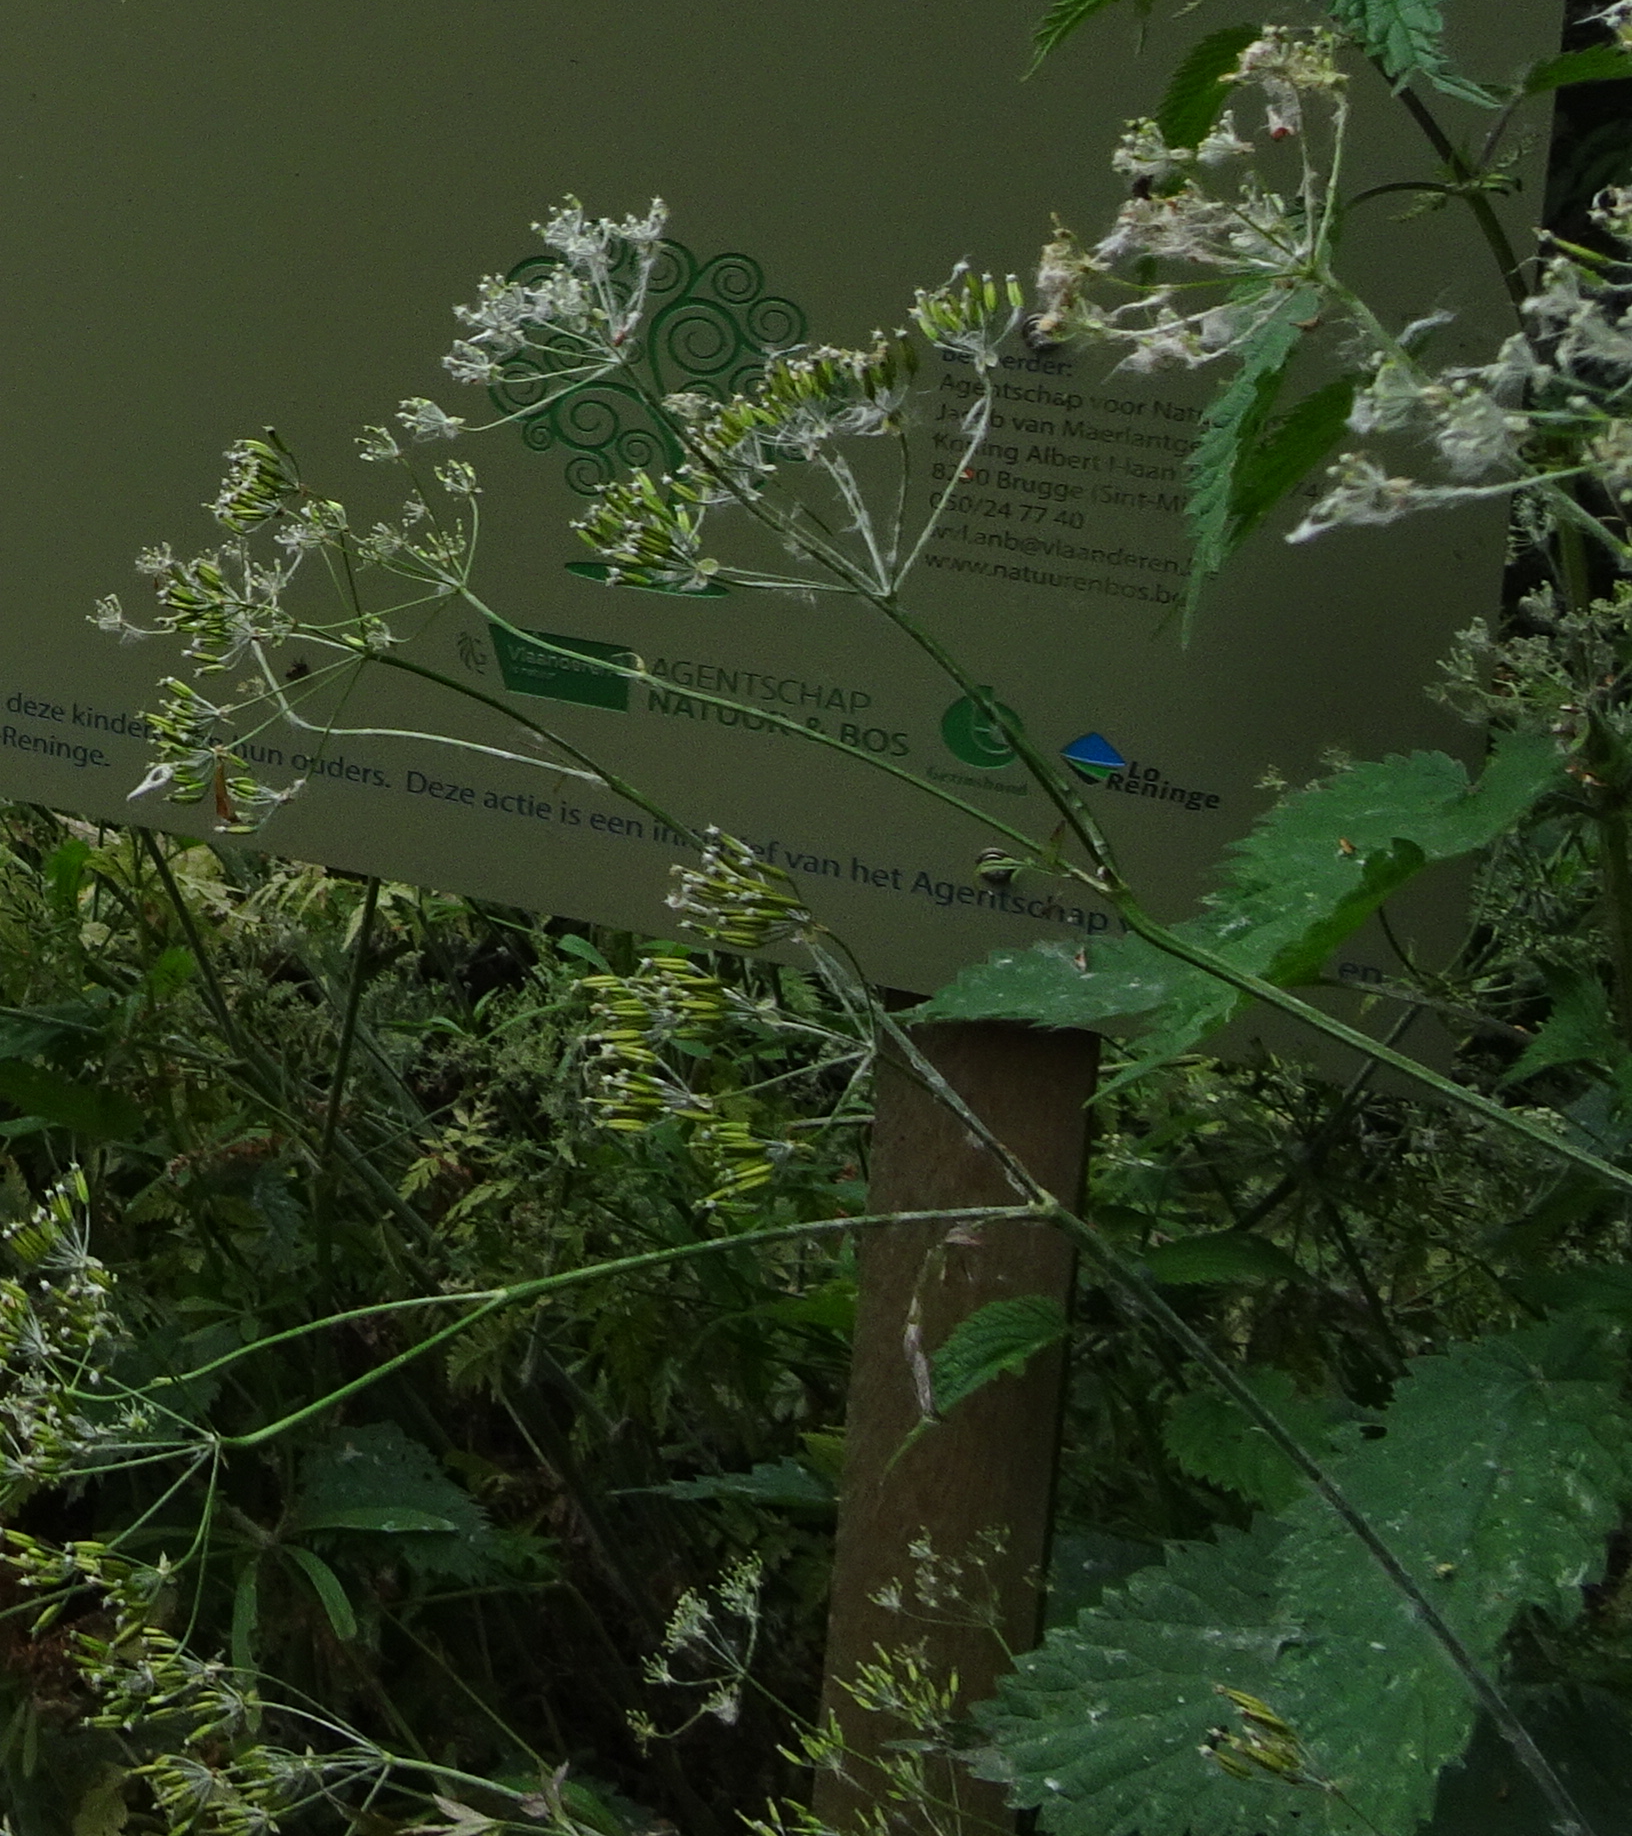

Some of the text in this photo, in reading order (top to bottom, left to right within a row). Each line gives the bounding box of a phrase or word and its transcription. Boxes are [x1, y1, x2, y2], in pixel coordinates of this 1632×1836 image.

[651, 658, 871, 714] AGENTSCHAP
[841, 723, 909, 756] BOS
[1129, 761, 1160, 781] Lo
[1106, 773, 1220, 810] Reninge
[6, 693, 65, 721] deze
[291, 755, 391, 788] ouders.
[407, 771, 475, 805] Deze
[484, 791, 551, 819] actie
[561, 801, 580, 825] is
[590, 814, 642, 838] een
[785, 852, 840, 877] van
[851, 857, 902, 890] het
[911, 869, 1108, 935] Agentschap
